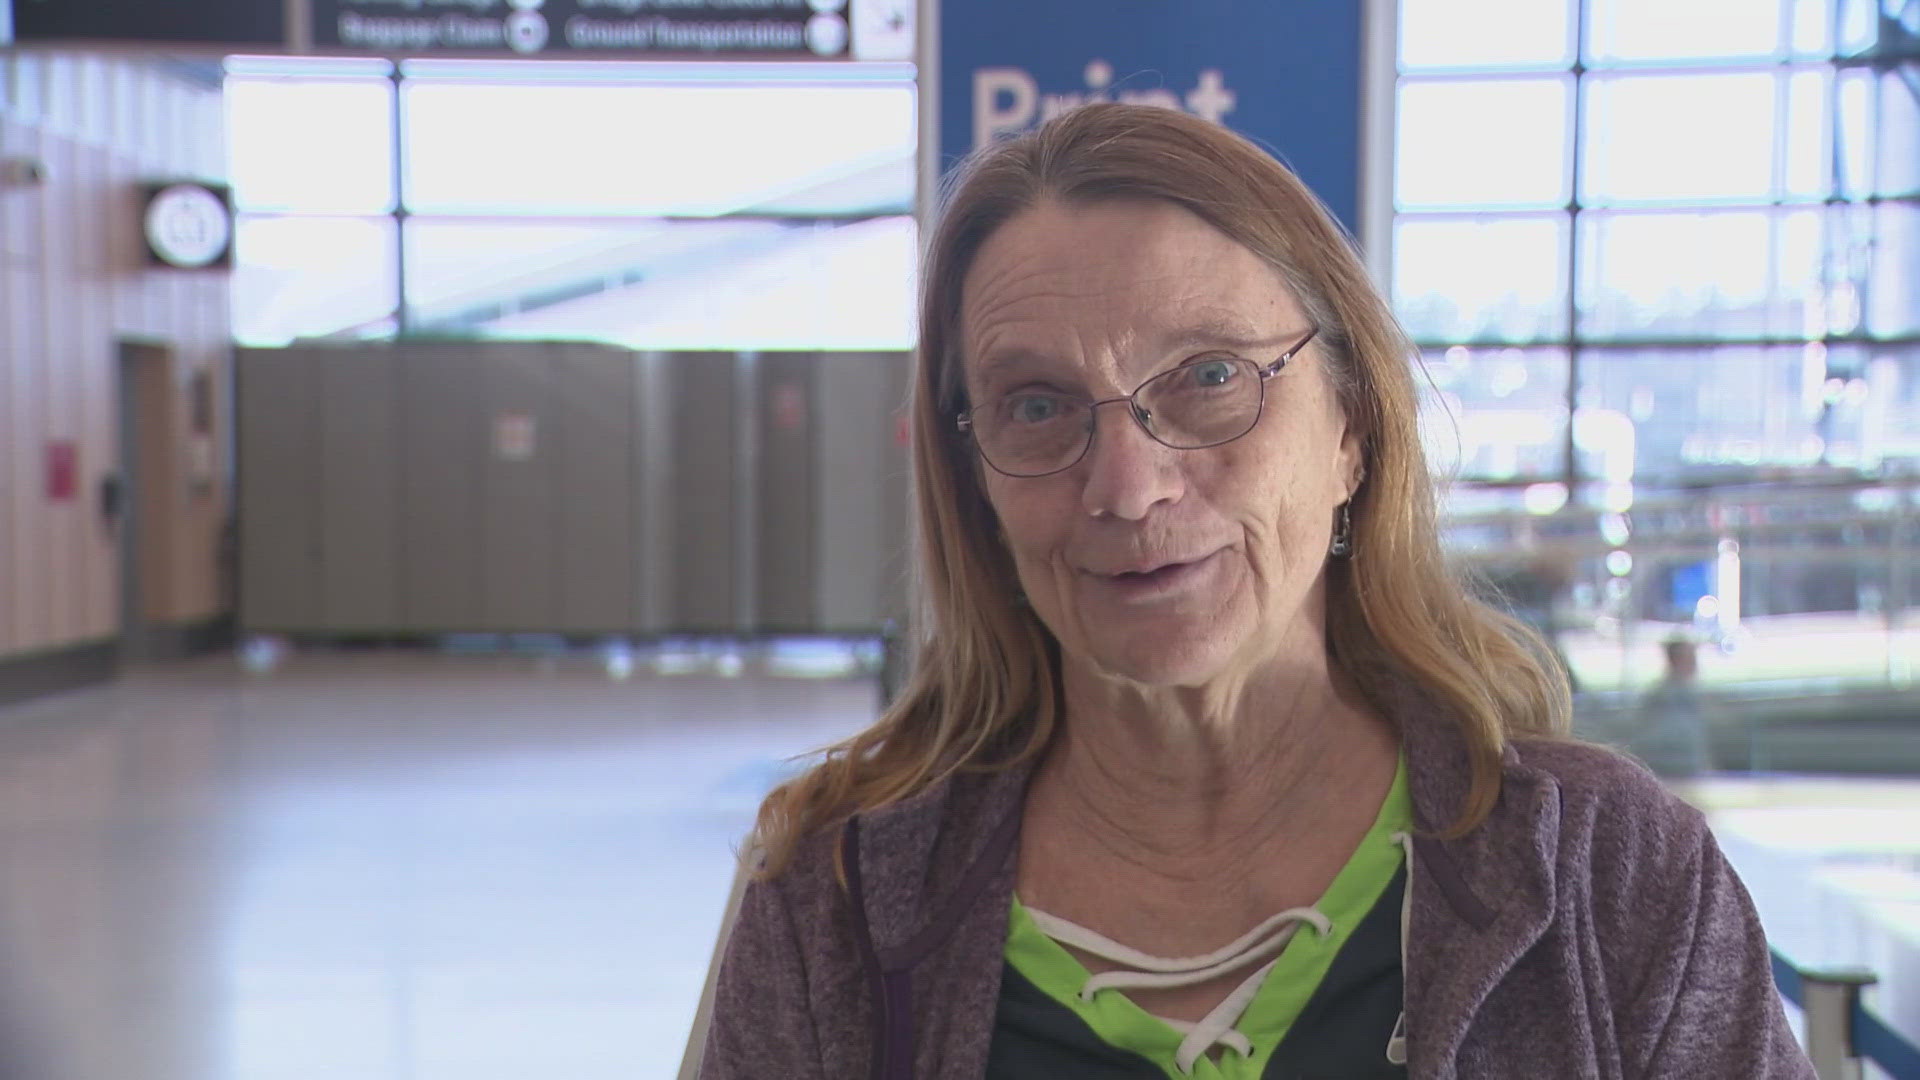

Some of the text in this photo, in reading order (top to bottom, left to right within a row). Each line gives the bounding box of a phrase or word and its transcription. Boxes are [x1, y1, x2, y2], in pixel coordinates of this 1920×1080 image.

[438, 13, 502, 47] Claim
[567, 16, 803, 50] Ground Transportation
[973, 60, 1236, 147] Prit
